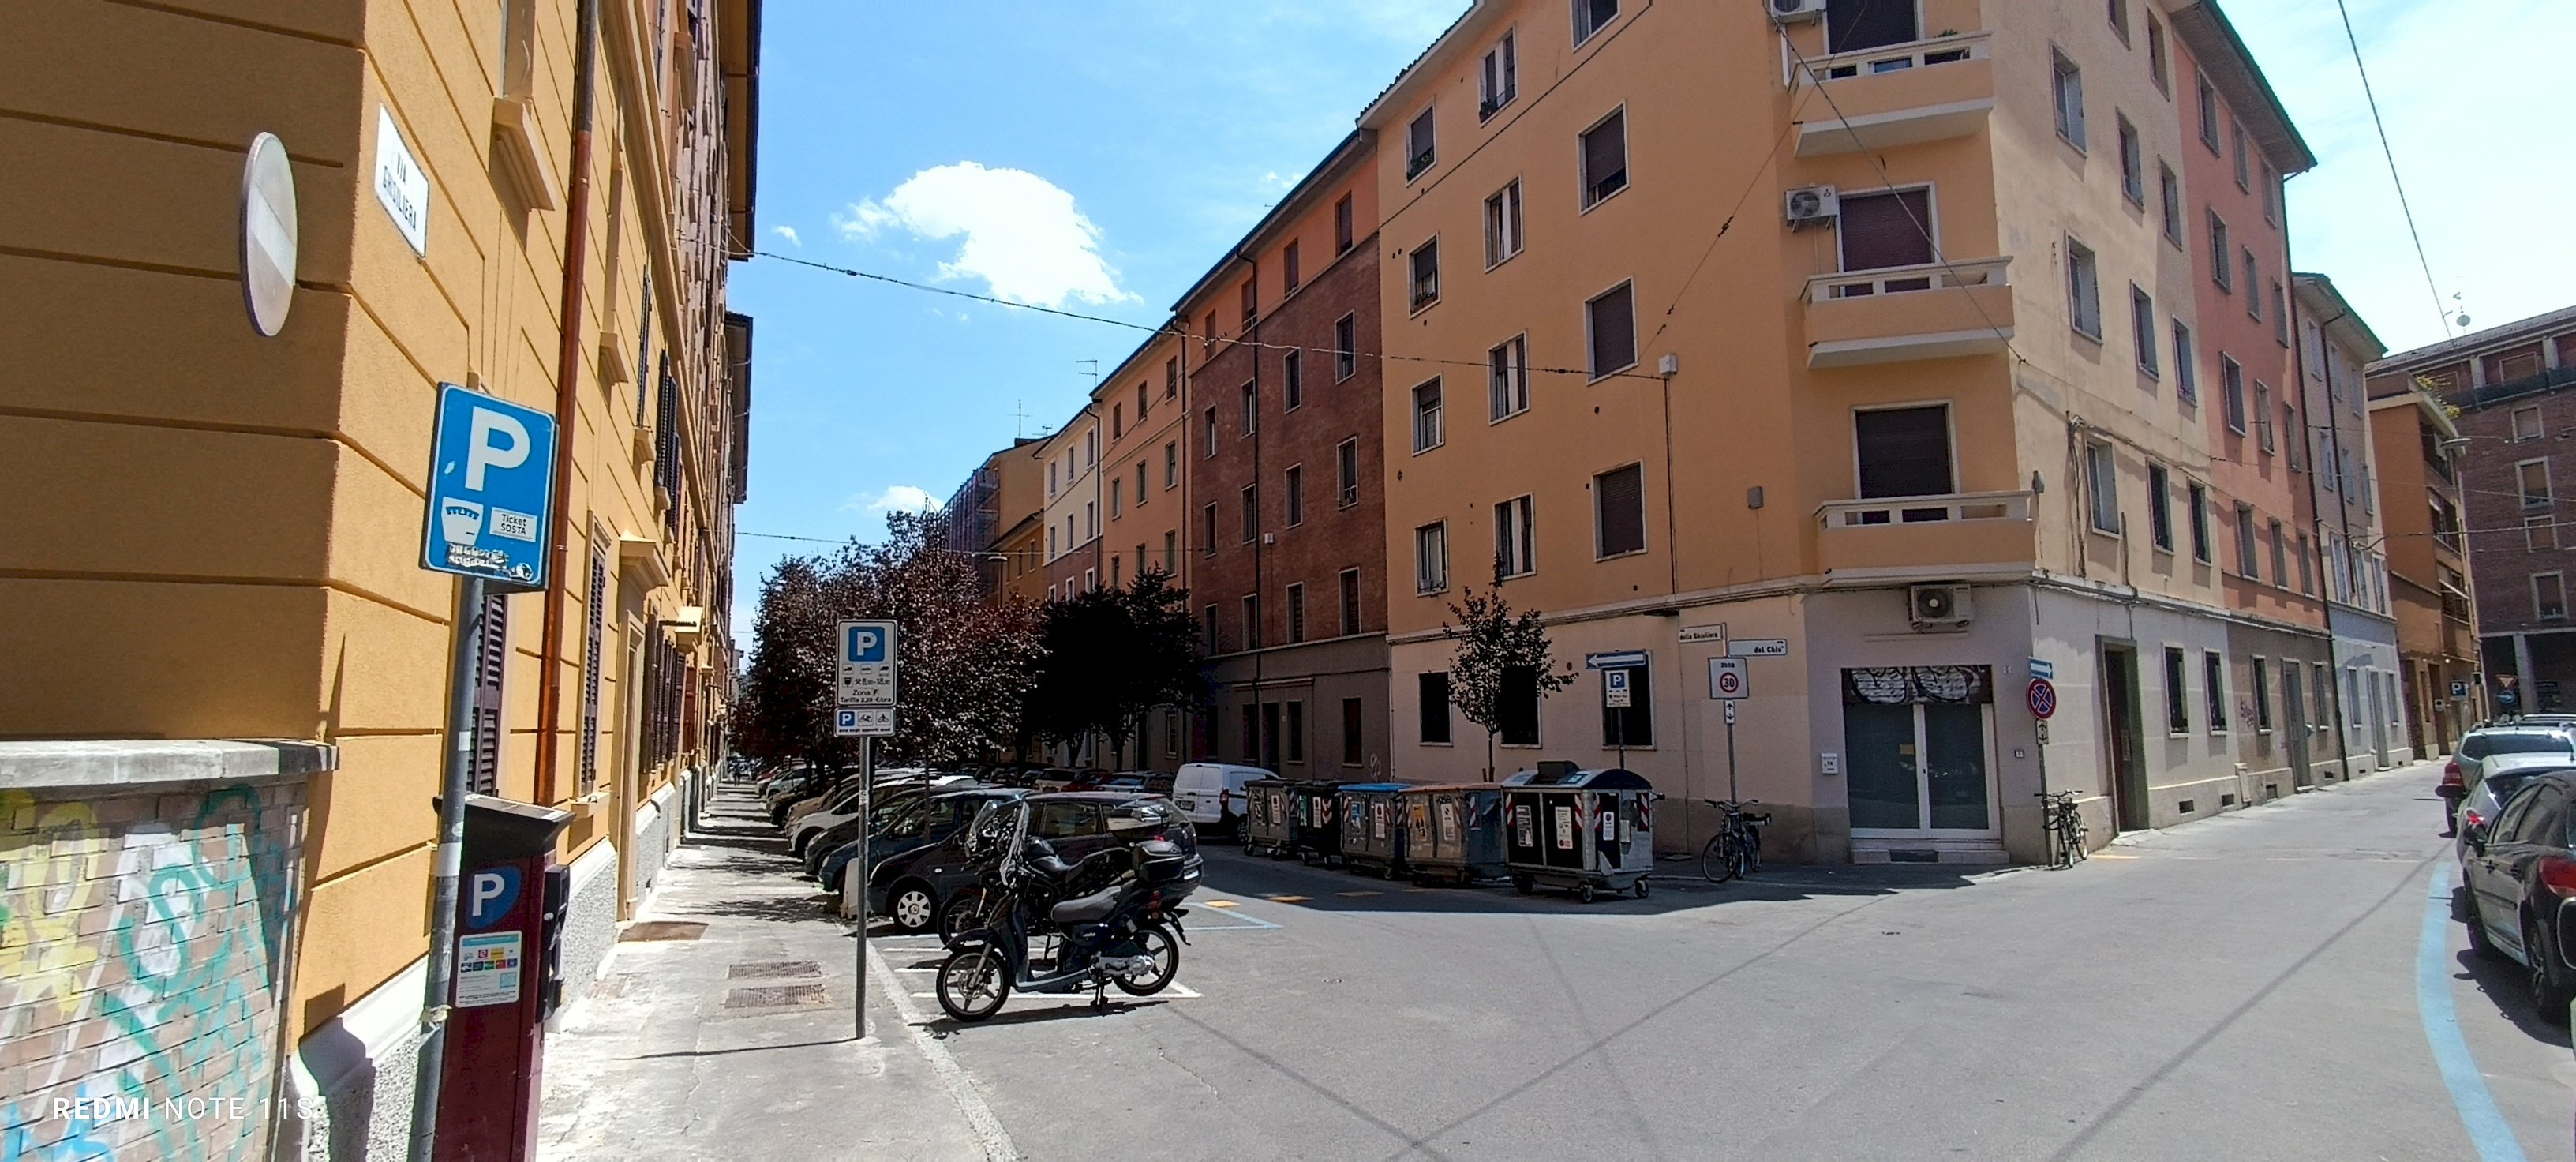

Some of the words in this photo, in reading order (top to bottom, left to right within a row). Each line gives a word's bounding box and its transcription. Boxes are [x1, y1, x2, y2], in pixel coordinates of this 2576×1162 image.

[397, 152, 406, 185] VIA
[465, 405, 531, 492] P
[502, 513, 526, 527] Ticket
[500, 523, 526, 535] SOSTA
[856, 631, 878, 657] P
[1613, 674, 1622, 686] P
[1724, 677, 1735, 688] 30
[2451, 683, 2462, 695] P
[842, 713, 852, 725] P
[472, 872, 505, 916] P
